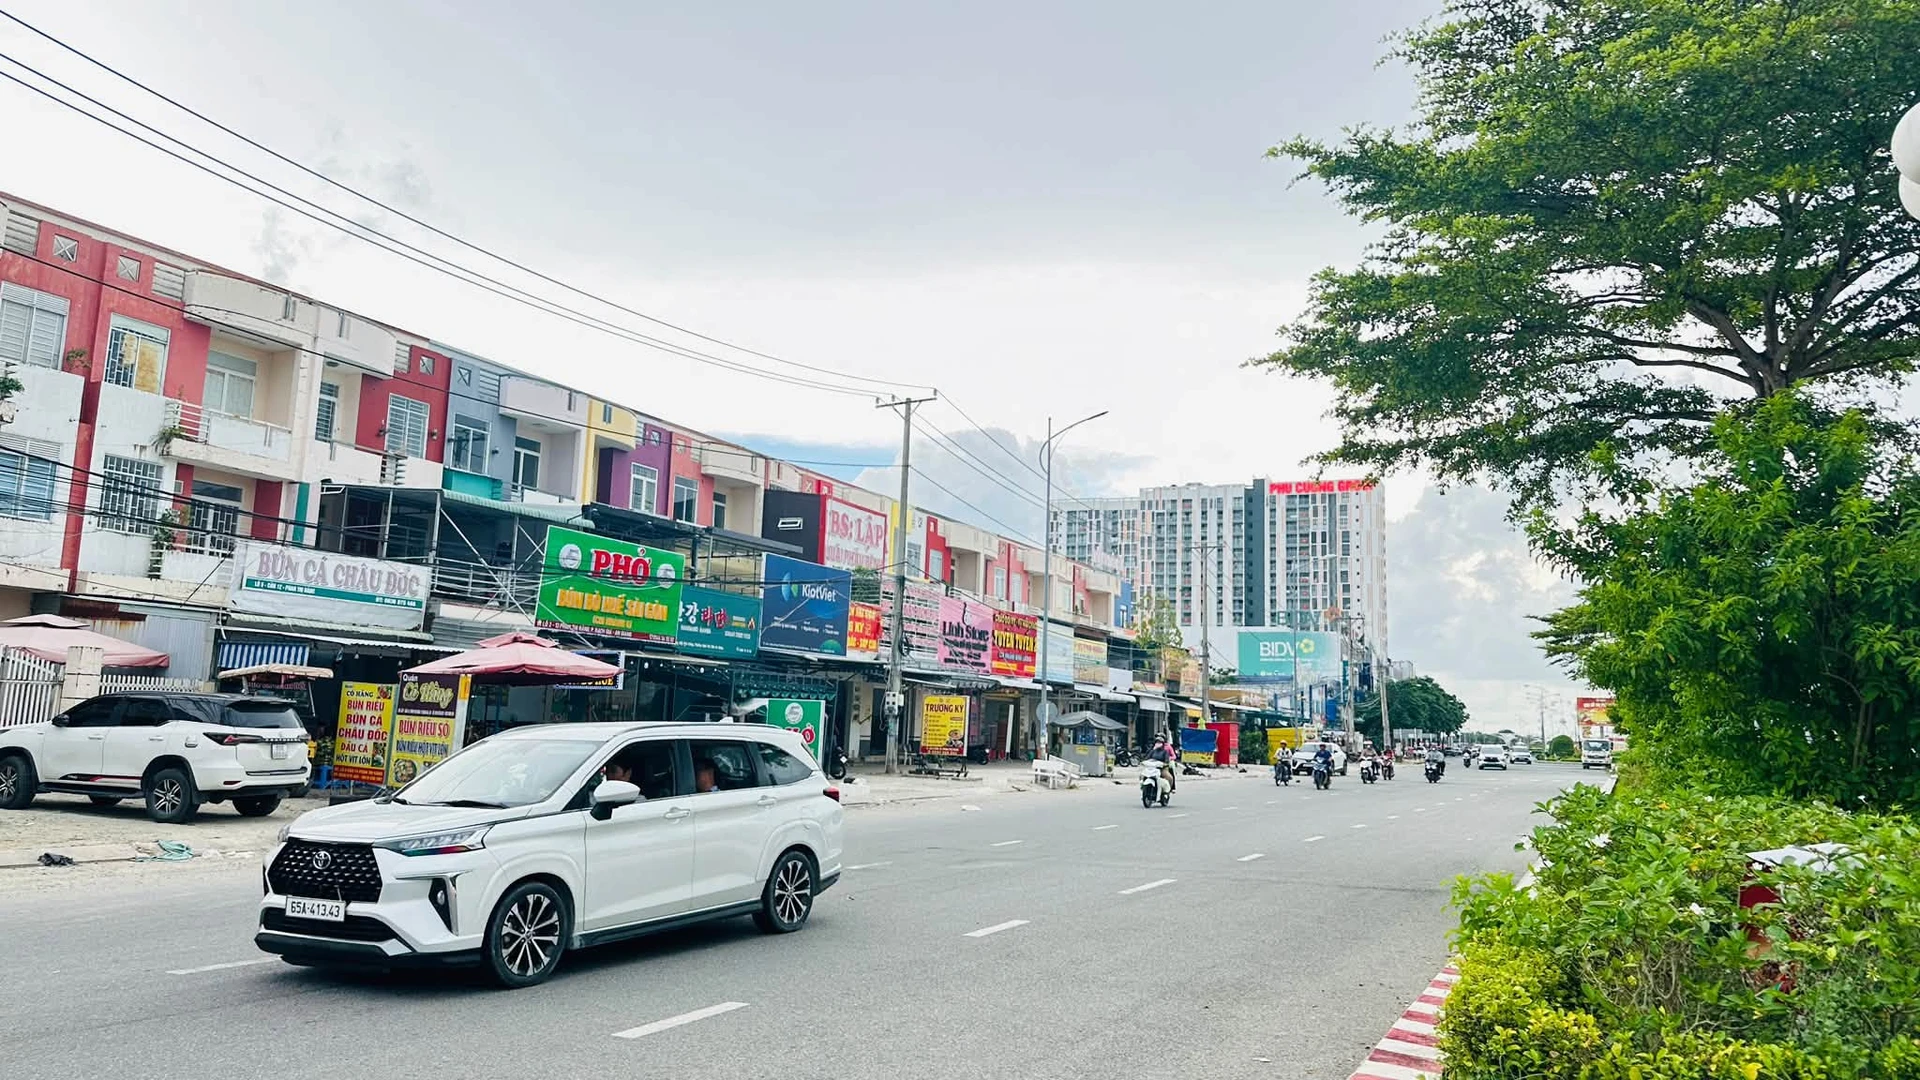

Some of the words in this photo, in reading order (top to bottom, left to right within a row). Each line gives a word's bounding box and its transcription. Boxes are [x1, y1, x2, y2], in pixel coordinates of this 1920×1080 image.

[855, 514, 884, 553] LẬP
[257, 549, 300, 581] BÚN
[303, 556, 329, 585] CÁ
[332, 562, 383, 592] CHÂU
[384, 566, 420, 597] ĐỐC
[590, 547, 652, 586] PHỞ
[556, 586, 584, 609] BÚN
[583, 590, 602, 611] BÒ
[600, 593, 626, 616] HUẾ
[624, 597, 645, 618] SÀI
[644, 599, 668, 621] GÒN
[943, 620, 964, 639] Linh
[965, 624, 990, 643] Store
[1259, 641, 1300, 657] BIDV
[338, 726, 365, 740] CHÂU
